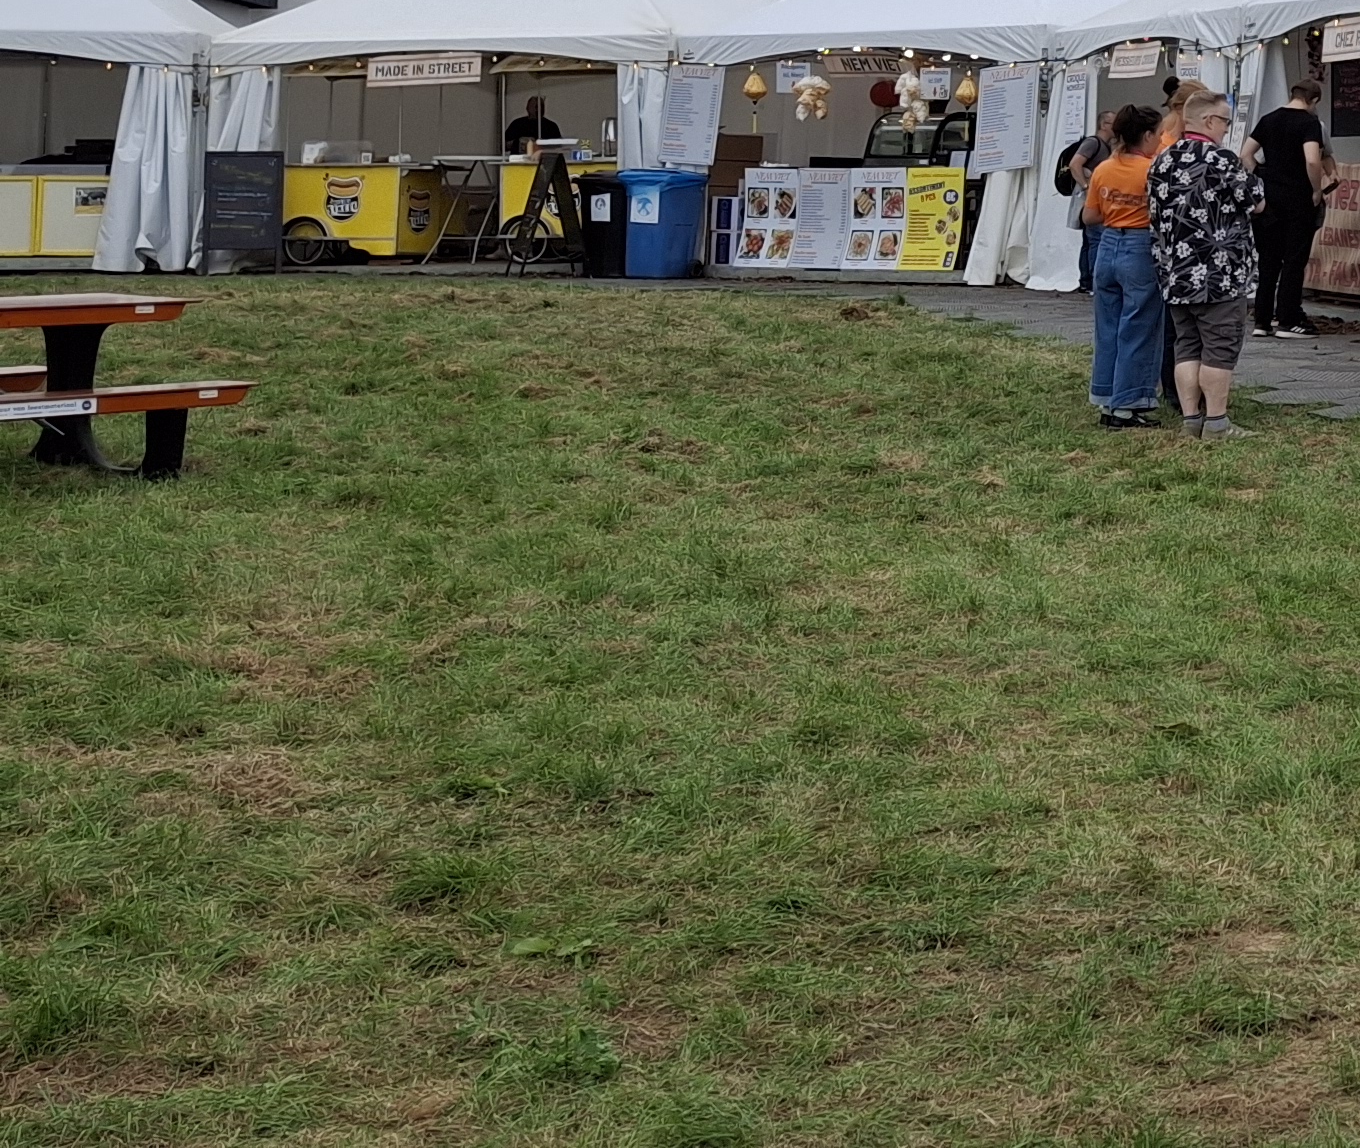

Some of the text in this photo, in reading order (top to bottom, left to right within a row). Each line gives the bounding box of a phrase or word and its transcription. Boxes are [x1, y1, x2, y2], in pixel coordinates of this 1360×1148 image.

[1335, 31, 1354, 48] CHEZ
[375, 61, 474, 78] MADE IN STREET
[841, 56, 871, 72] NEM
